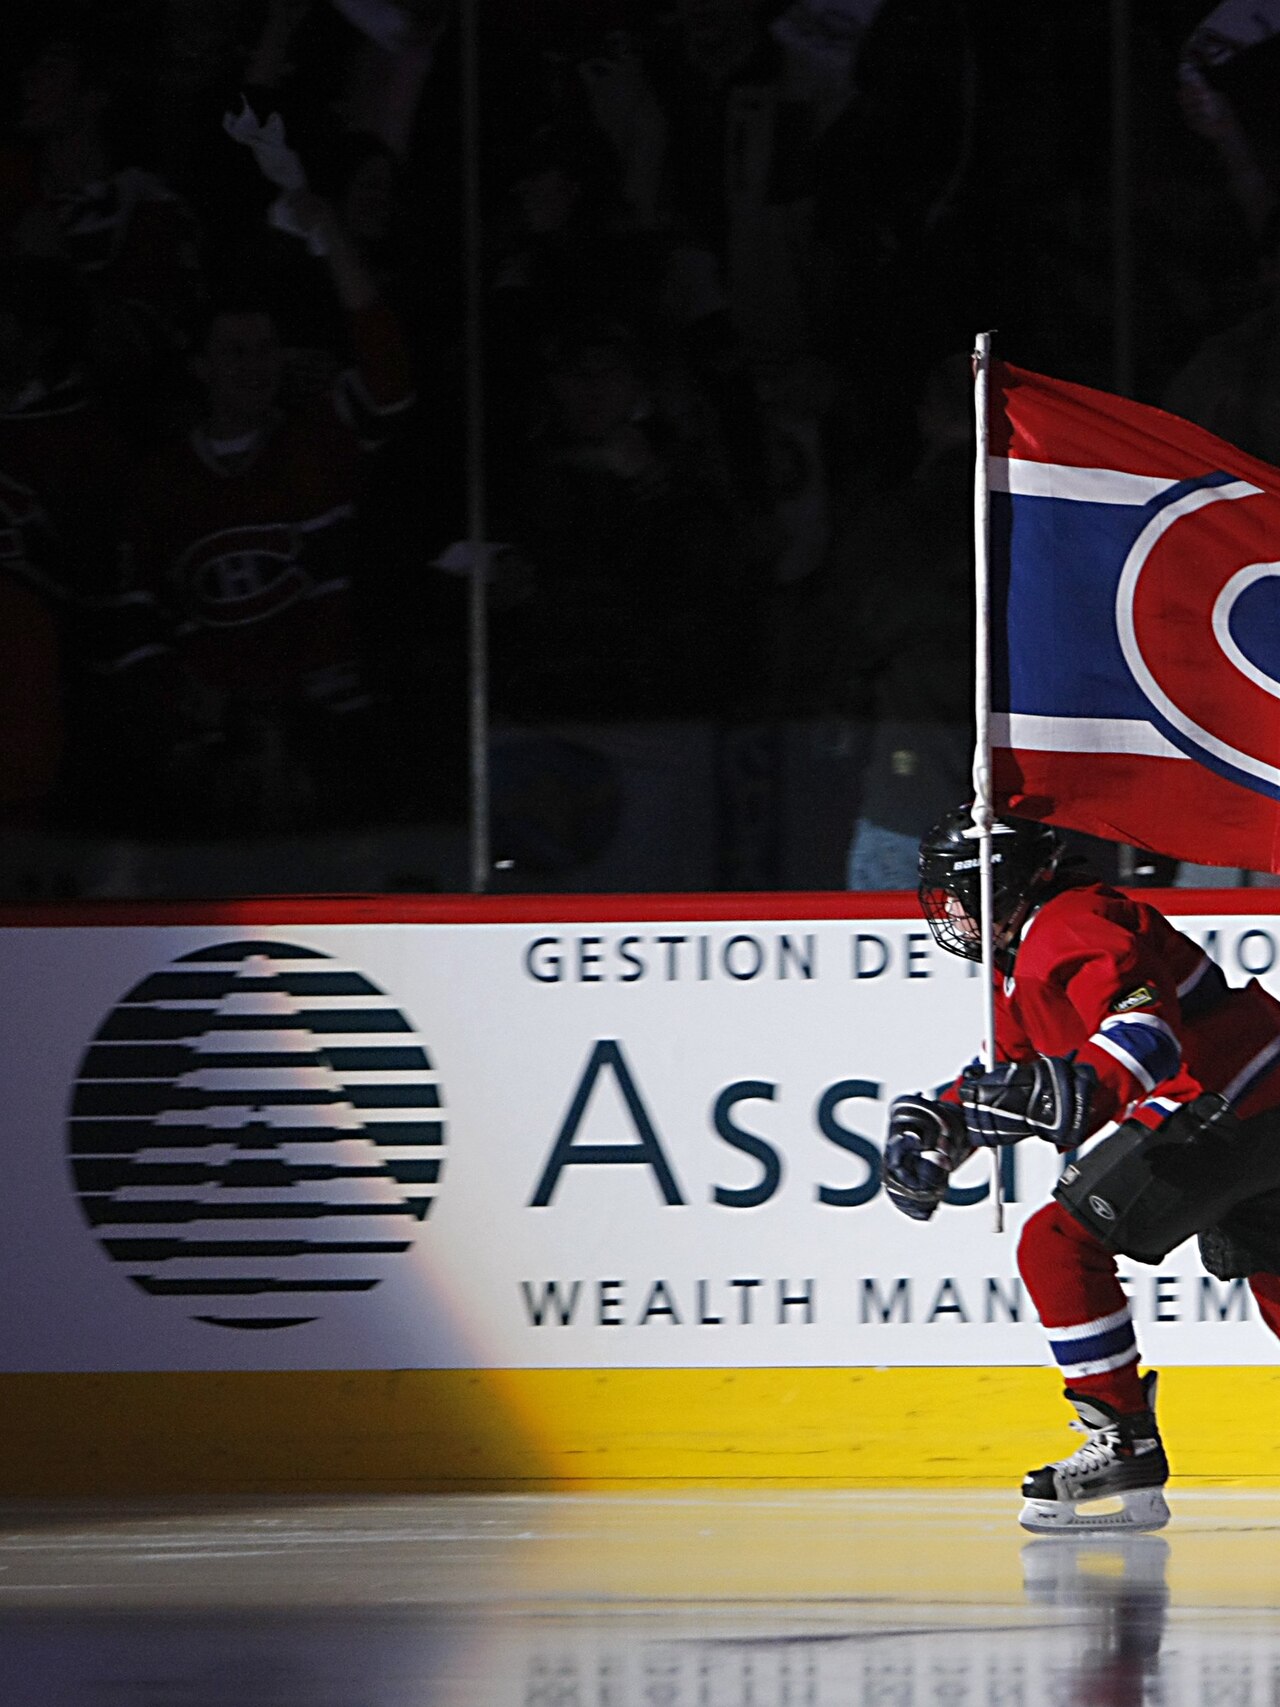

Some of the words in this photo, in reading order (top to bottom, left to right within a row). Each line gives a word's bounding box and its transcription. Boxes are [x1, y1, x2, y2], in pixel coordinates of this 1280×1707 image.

[953, 853, 1003, 871] BAUR
[524, 933, 817, 983] GESTION
[854, 933, 932, 980] DE
[520, 1277, 817, 1327] WEALTH
